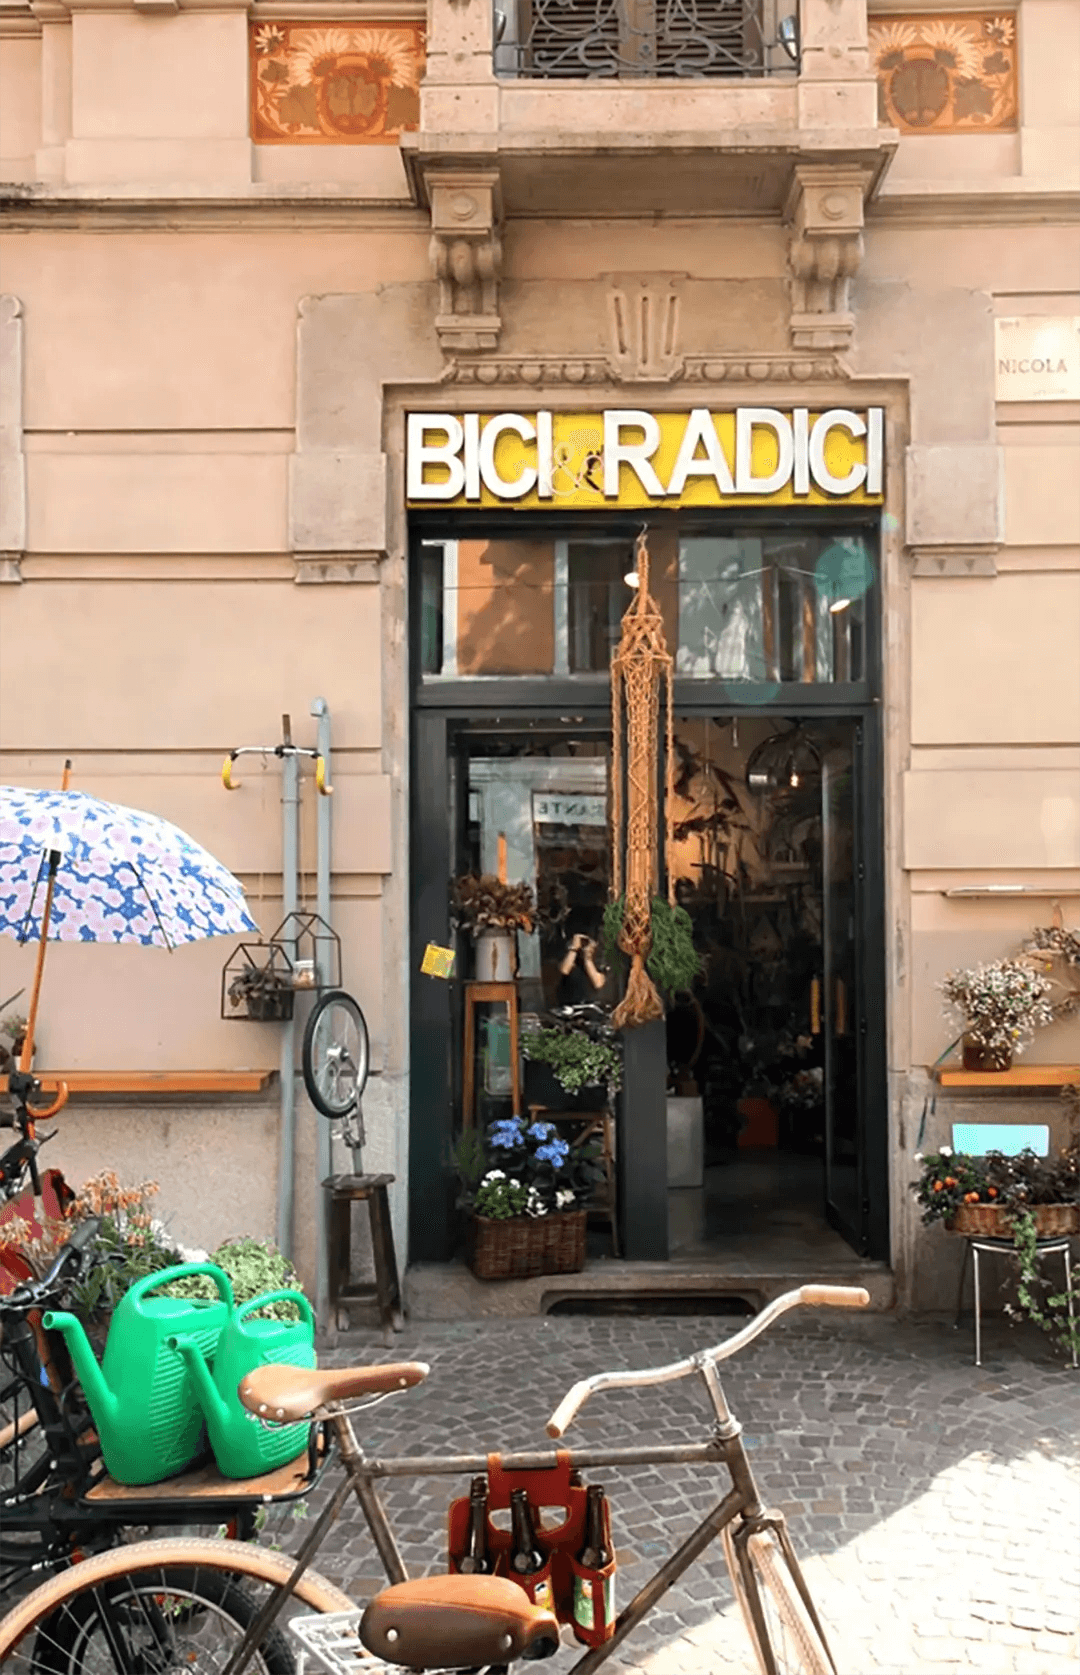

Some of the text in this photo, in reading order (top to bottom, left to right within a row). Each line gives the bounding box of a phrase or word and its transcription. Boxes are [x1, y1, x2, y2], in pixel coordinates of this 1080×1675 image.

[998, 358, 1068, 375] NICOLA
[406, 409, 553, 499] BICI
[603, 406, 884, 497] RADICI
